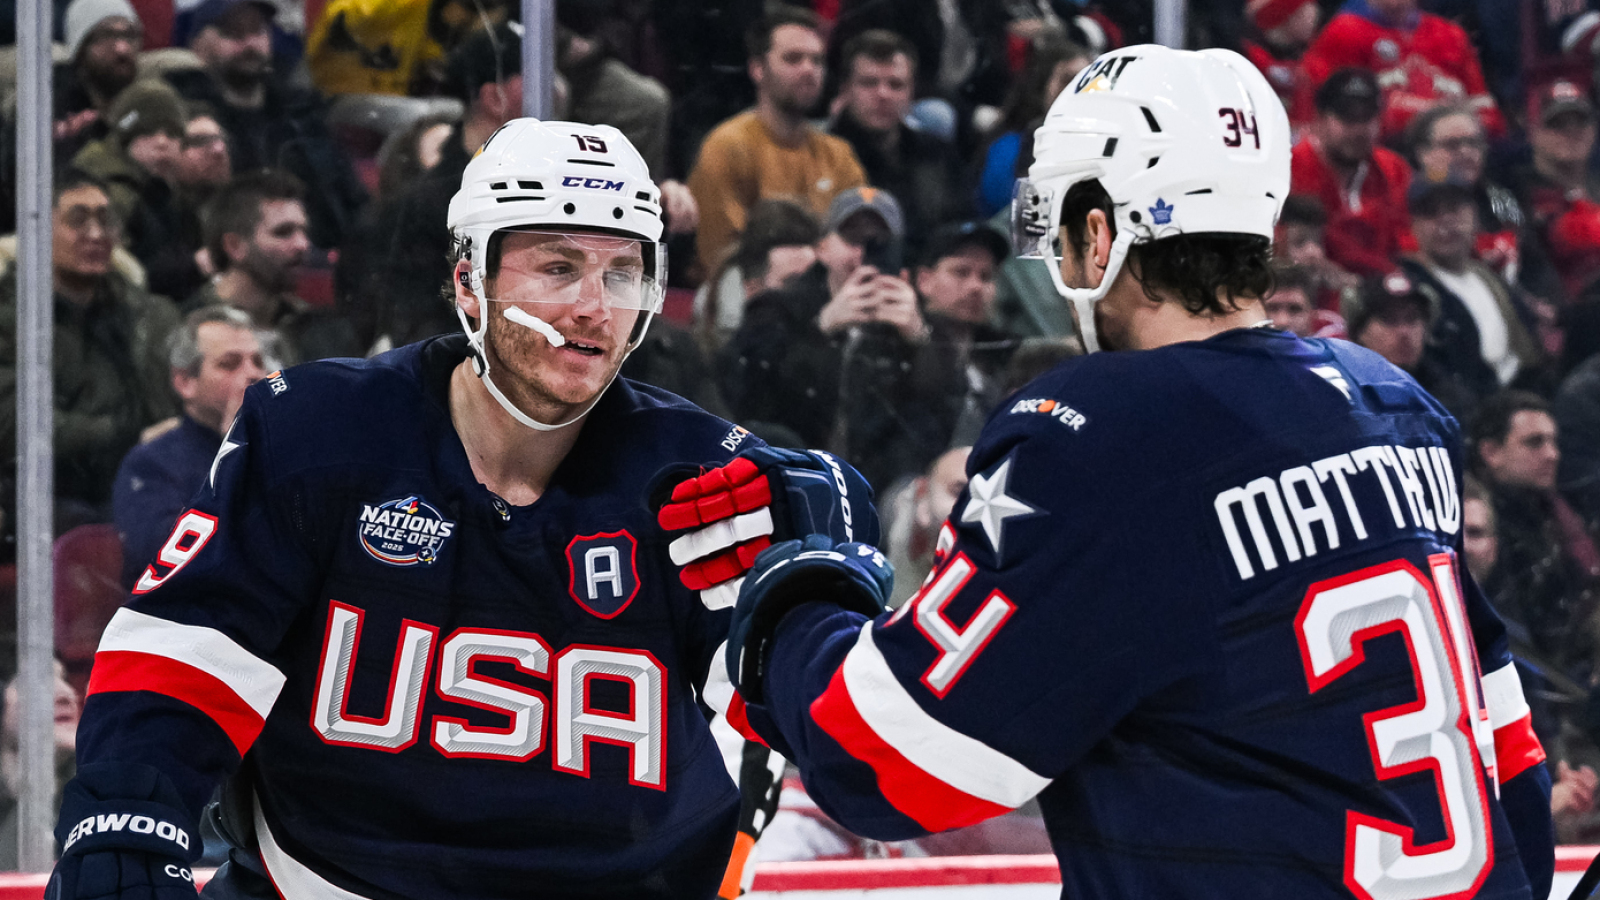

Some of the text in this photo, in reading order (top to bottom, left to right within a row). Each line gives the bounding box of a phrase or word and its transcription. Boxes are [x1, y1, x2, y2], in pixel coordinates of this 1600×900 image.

[1074, 56, 1138, 94] CAT
[1218, 107, 1260, 150] 34
[561, 175, 625, 192] CCM
[359, 503, 455, 538] NATIONS
[131, 508, 219, 595] 9
[381, 541, 404, 552] 2025
[584, 545, 624, 600] A
[309, 599, 667, 792] USA
